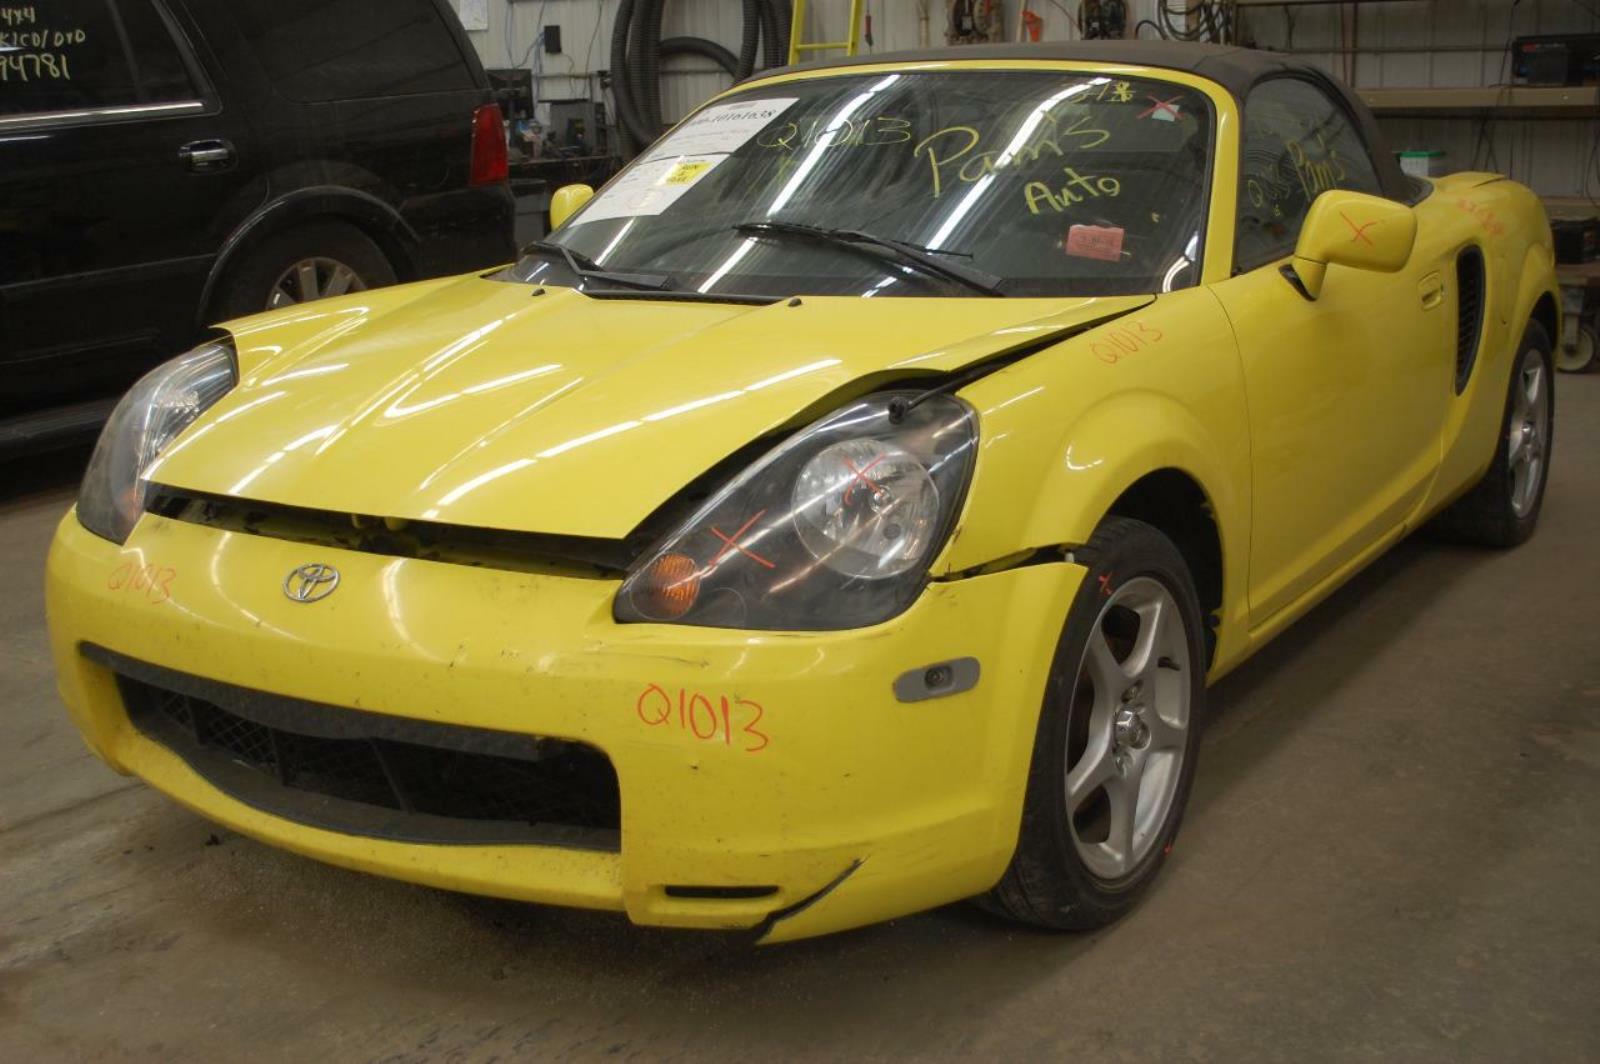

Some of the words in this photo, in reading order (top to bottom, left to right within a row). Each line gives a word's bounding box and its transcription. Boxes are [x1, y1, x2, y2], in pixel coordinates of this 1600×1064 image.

[757, 119, 911, 150] Q1013
[1024, 167, 1120, 214] Auto
[1088, 321, 1163, 364] Q1013
[637, 683, 768, 751] Q1013
